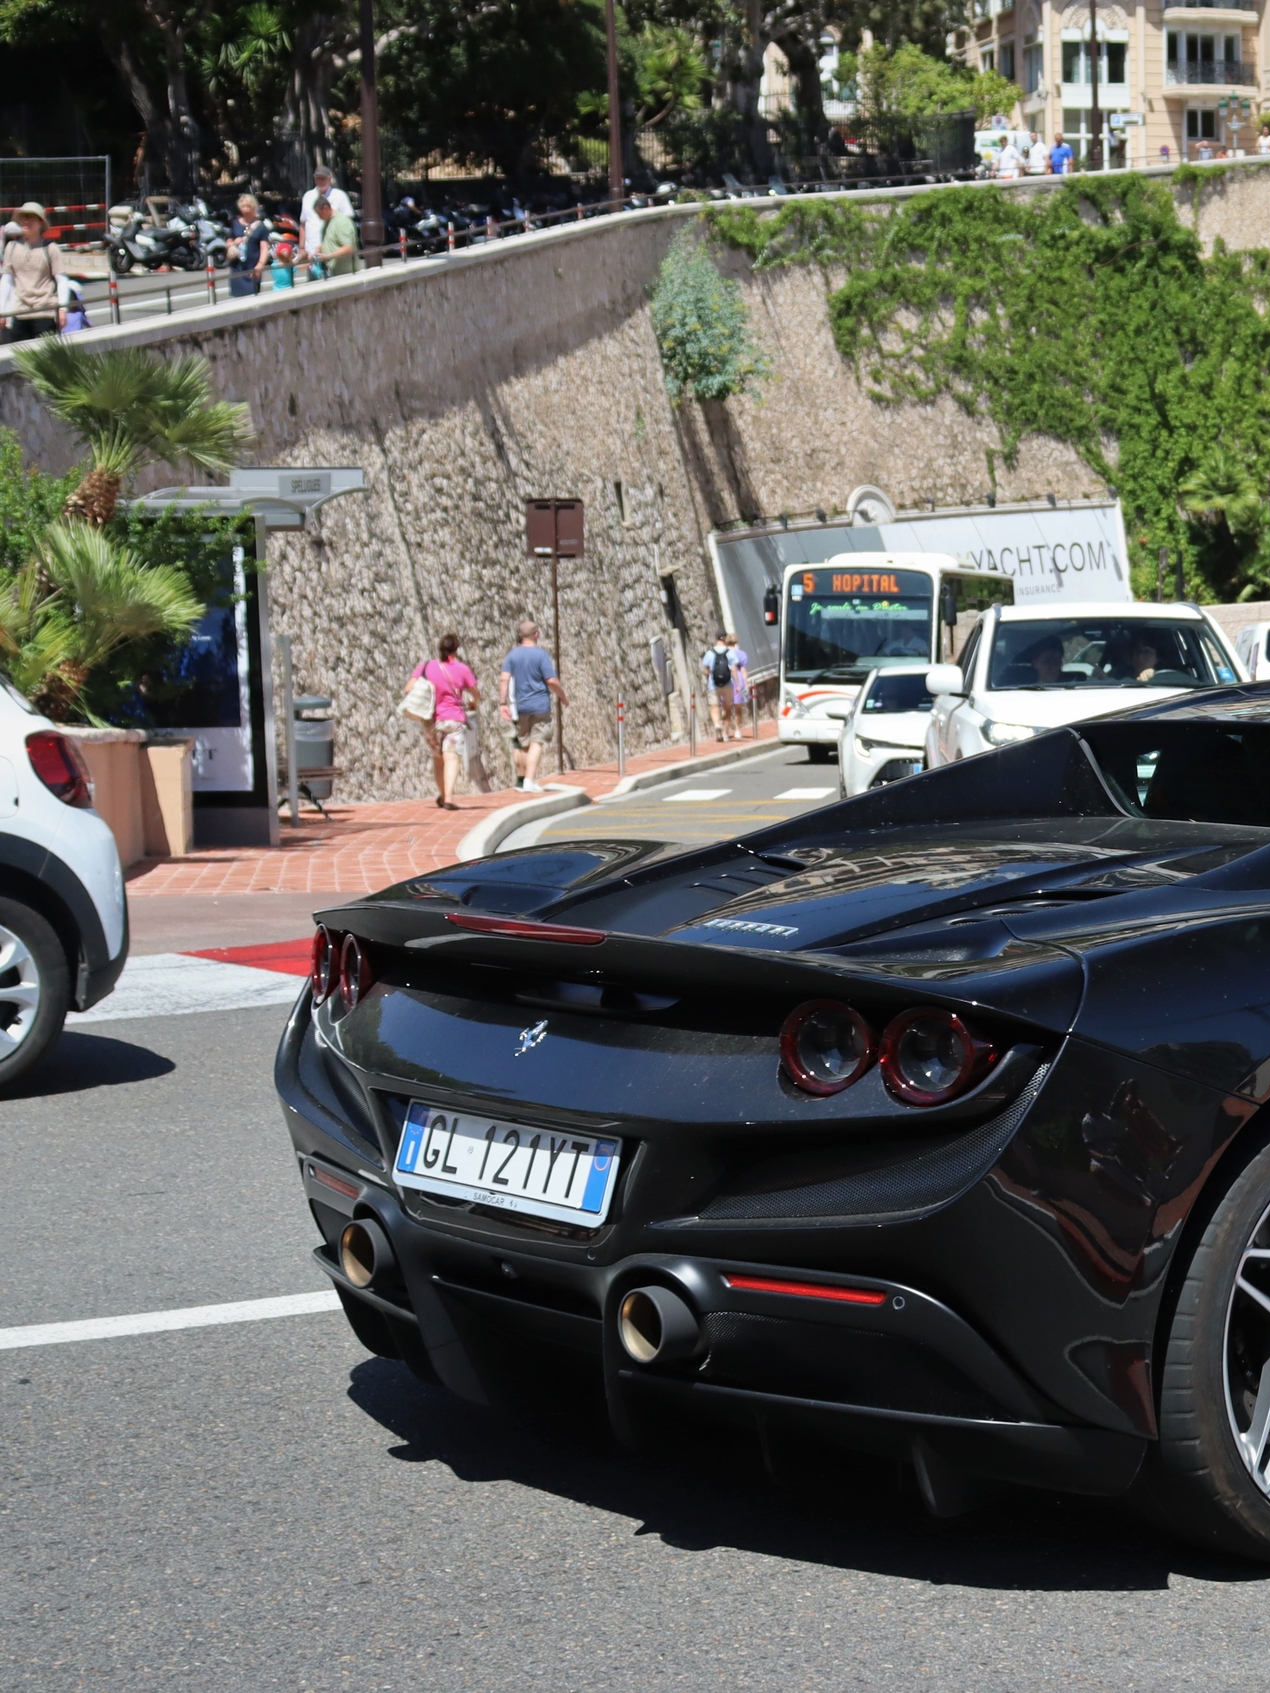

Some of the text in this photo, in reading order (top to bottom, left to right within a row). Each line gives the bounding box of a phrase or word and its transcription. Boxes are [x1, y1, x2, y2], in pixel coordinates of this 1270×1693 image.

[803, 573, 899, 593] 5 HOPITAL
[1016, 584, 1061, 596] INSURANCE
[423, 1114, 589, 1199] GL 121YT
[473, 1192, 505, 1206] SAMOCAR
